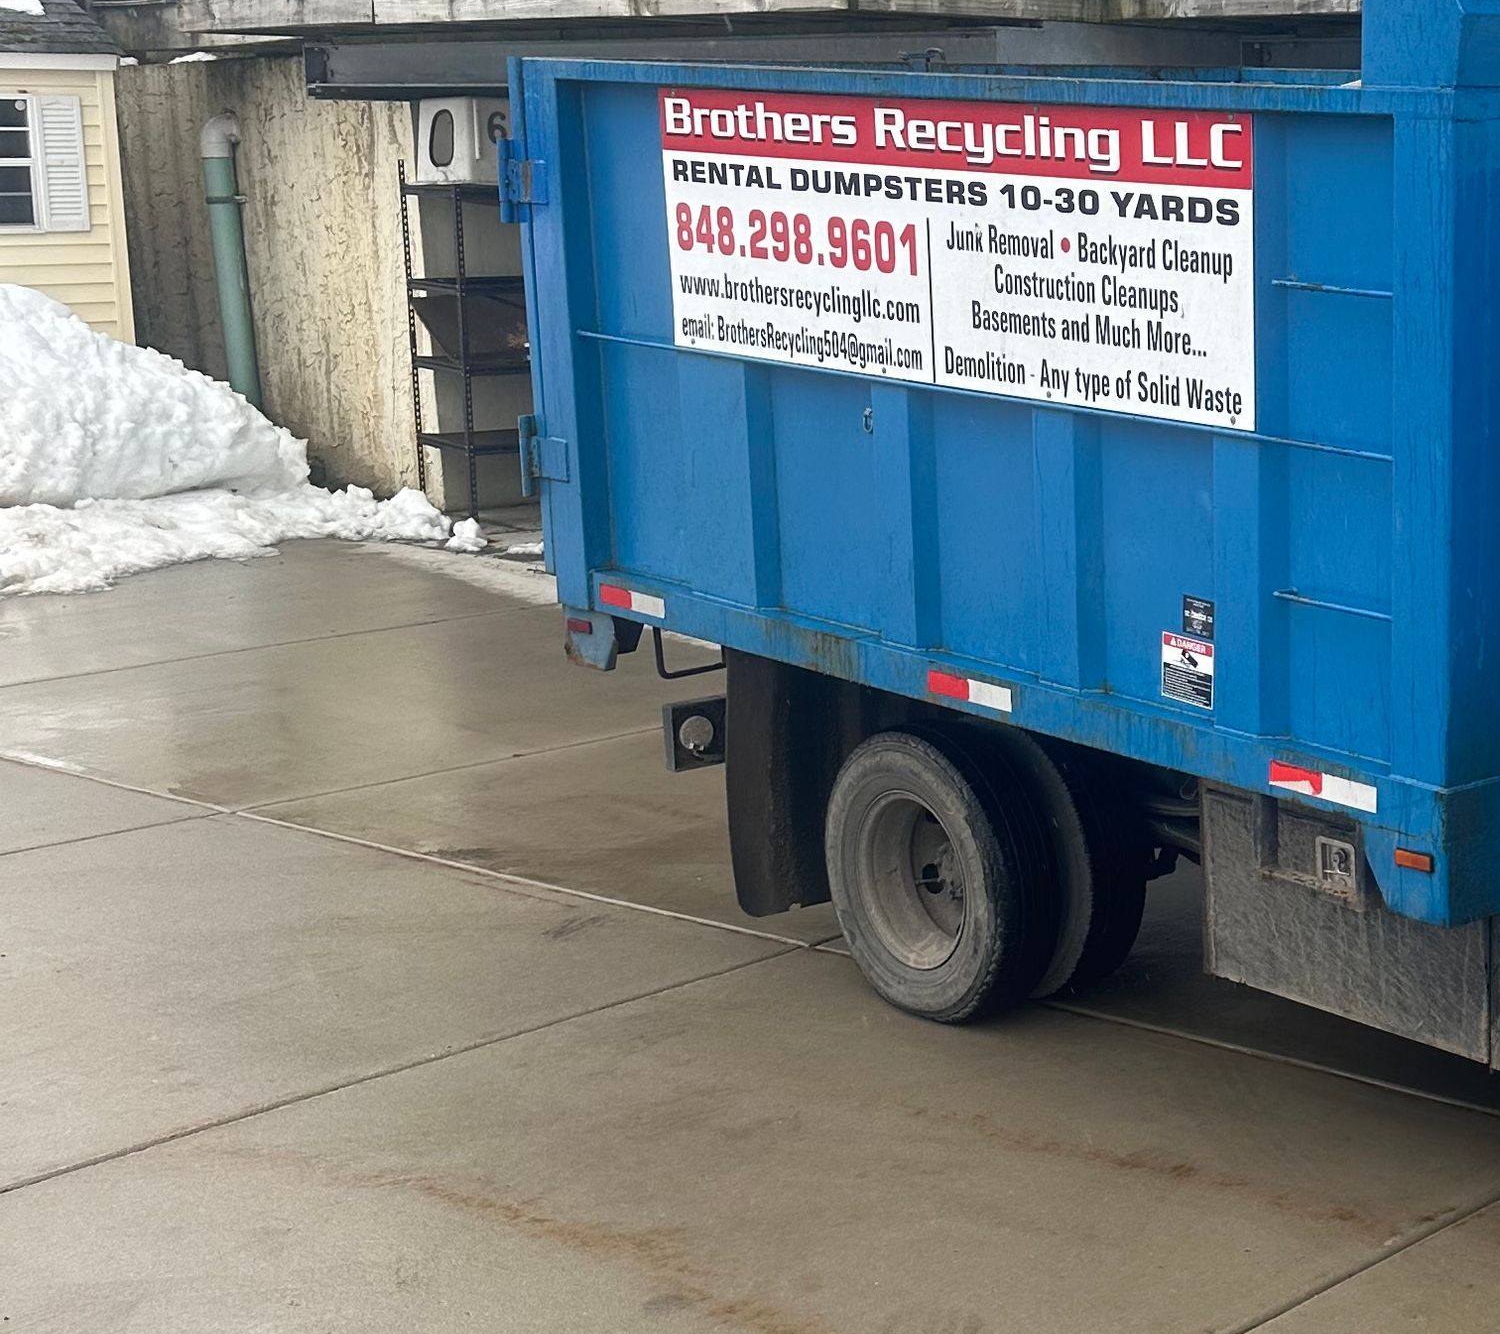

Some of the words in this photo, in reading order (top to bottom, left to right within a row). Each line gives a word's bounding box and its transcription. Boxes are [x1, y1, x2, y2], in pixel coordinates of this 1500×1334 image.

[663, 97, 858, 146] Brothers
[874, 107, 1121, 173] Recycling
[1141, 120, 1244, 169] LLC
[672, 159, 782, 190] RENTAL
[790, 168, 988, 207] DUMPSTERS
[999, 184, 1100, 216] 10-30
[1110, 191, 1240, 227] YARDS
[675, 202, 918, 276] 848.298.9601
[946, 221, 983, 253] Junk
[988, 224, 1054, 259] Removal
[1077, 232, 1156, 273] Backyard
[1162, 239, 1233, 284] Cleanup
[680, 273, 920, 324] www.brothersrecyclingllc.com
[994, 264, 1096, 304] Construction
[1101, 275, 1179, 318] Cleanups
[682, 314, 715, 341] email:
[717, 315, 923, 371] BrothersRecycling504@gmail.com
[971, 300, 1056, 340] Basements
[1061, 313, 1090, 343] and
[1095, 315, 1140, 349] Much
[1147, 320, 1207, 357] More...
[944, 346, 1026, 385] Demolition
[1040, 358, 1070, 398] Any
[1075, 367, 1110, 402] type
[1116, 370, 1131, 400] of
[1137, 370, 1180, 407] Solid
[1185, 378, 1242, 416] Waste
[1177, 638, 1206, 654] DANGER
